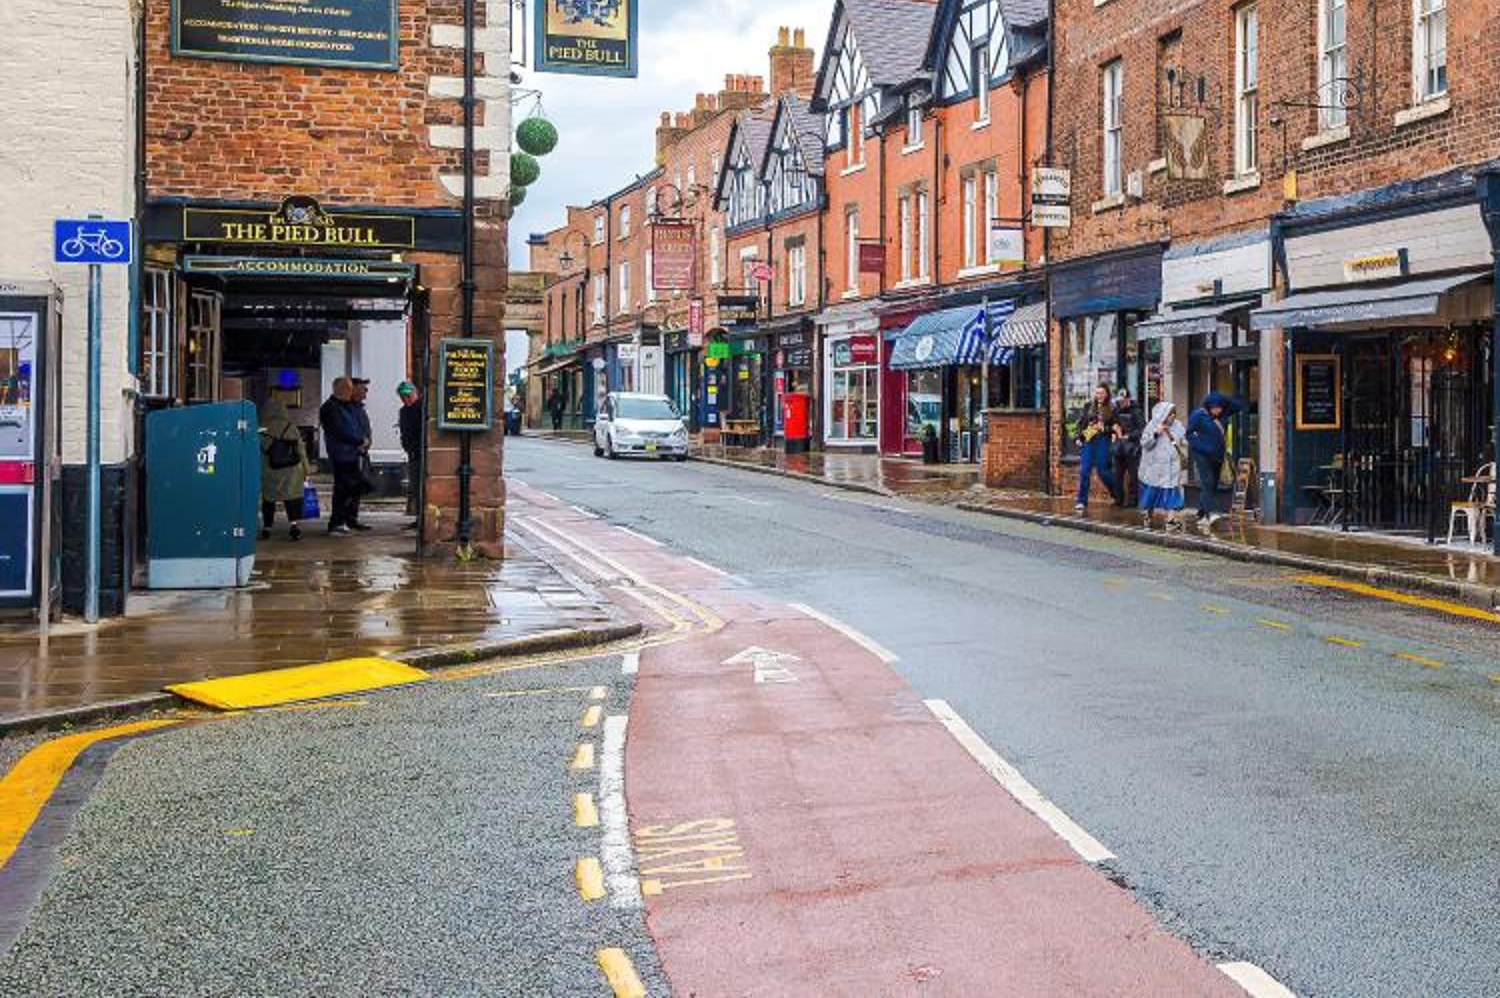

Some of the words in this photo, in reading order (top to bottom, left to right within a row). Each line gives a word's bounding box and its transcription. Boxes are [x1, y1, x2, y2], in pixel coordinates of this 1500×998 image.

[576, 39, 597, 49] THE
[549, 47, 583, 59] PIED
[586, 49, 625, 63] BULL
[222, 223, 267, 240] THE
[271, 224, 319, 242] PIED
[325, 225, 380, 244] BULL
[237, 260, 369, 274] ACCOMMODATION
